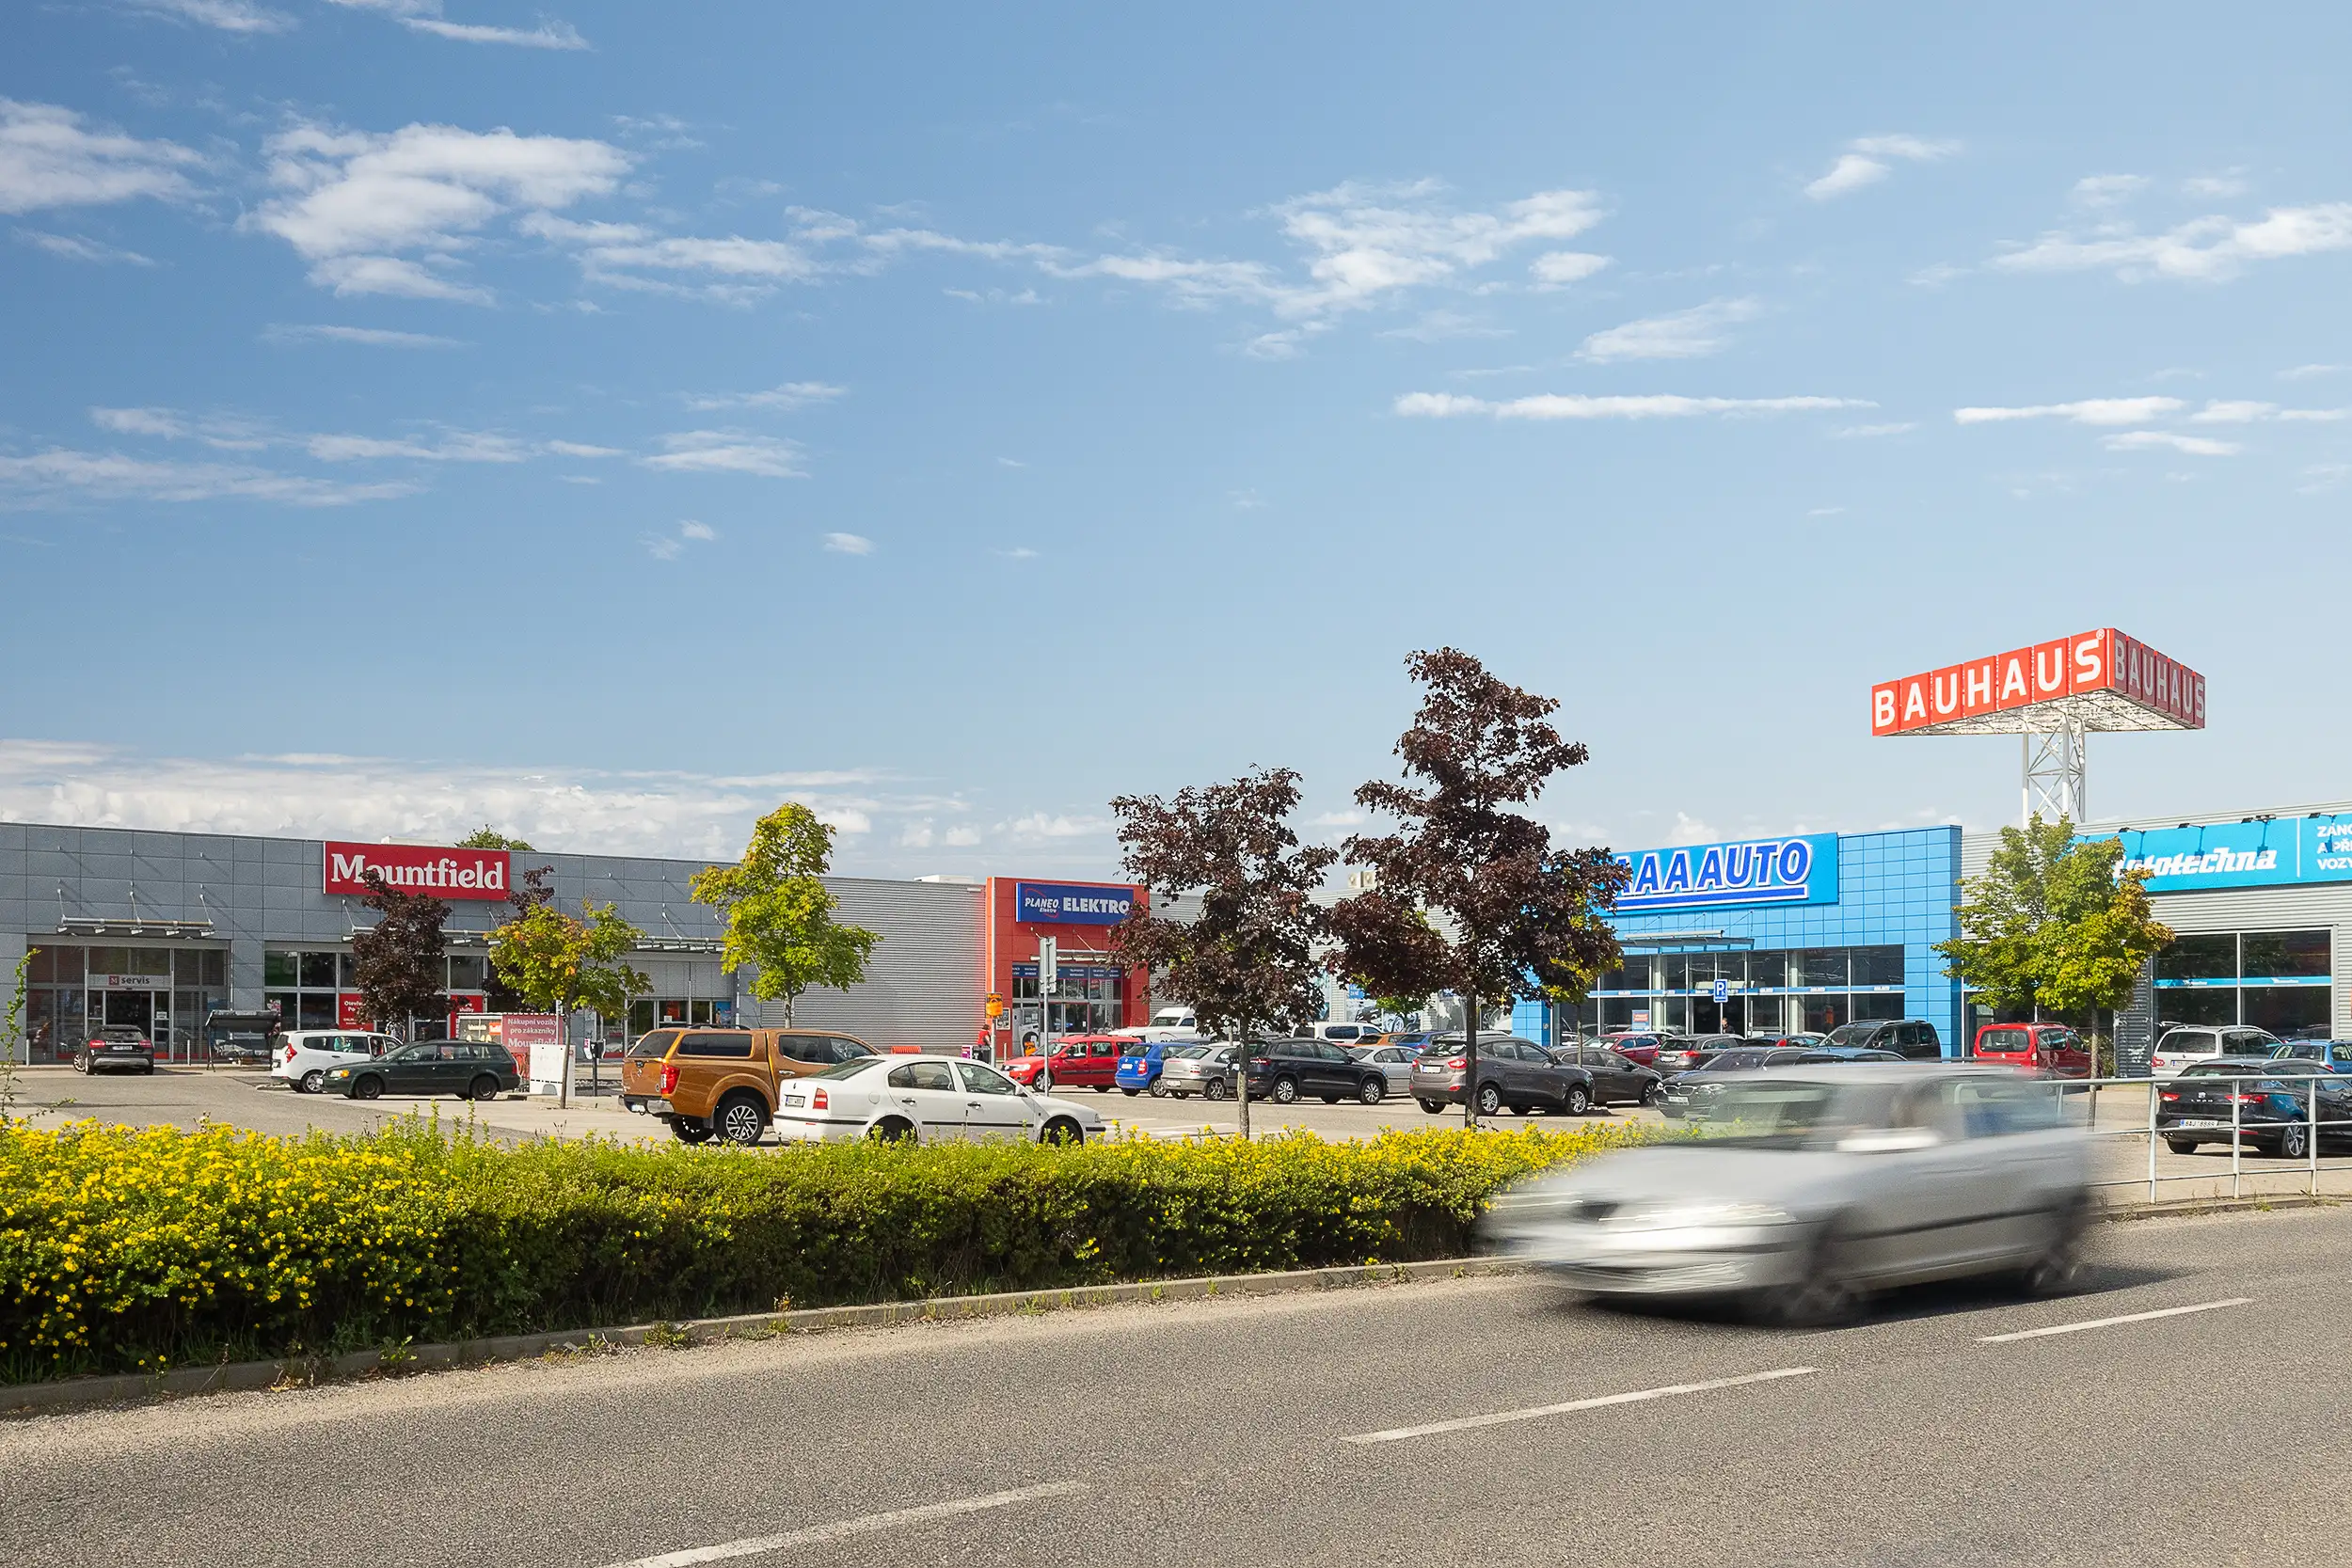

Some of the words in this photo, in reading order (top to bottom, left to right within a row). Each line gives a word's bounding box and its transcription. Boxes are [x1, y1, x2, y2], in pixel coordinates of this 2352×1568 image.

[1875, 638, 2102, 728] BAUHAUS
[2115, 639, 2203, 719] BAUHAUS
[2317, 823, 2352, 837] ZÁN
[331, 853, 504, 890] Mountfield
[1694, 839, 1812, 889] AUTO
[1025, 897, 1059, 909] PLANEO
[1063, 896, 1130, 915] ELEKTRO
[121, 975, 150, 985] servis
[508, 1018, 536, 1026] Nákupní
[522, 1026, 556, 1035] zákazníky
